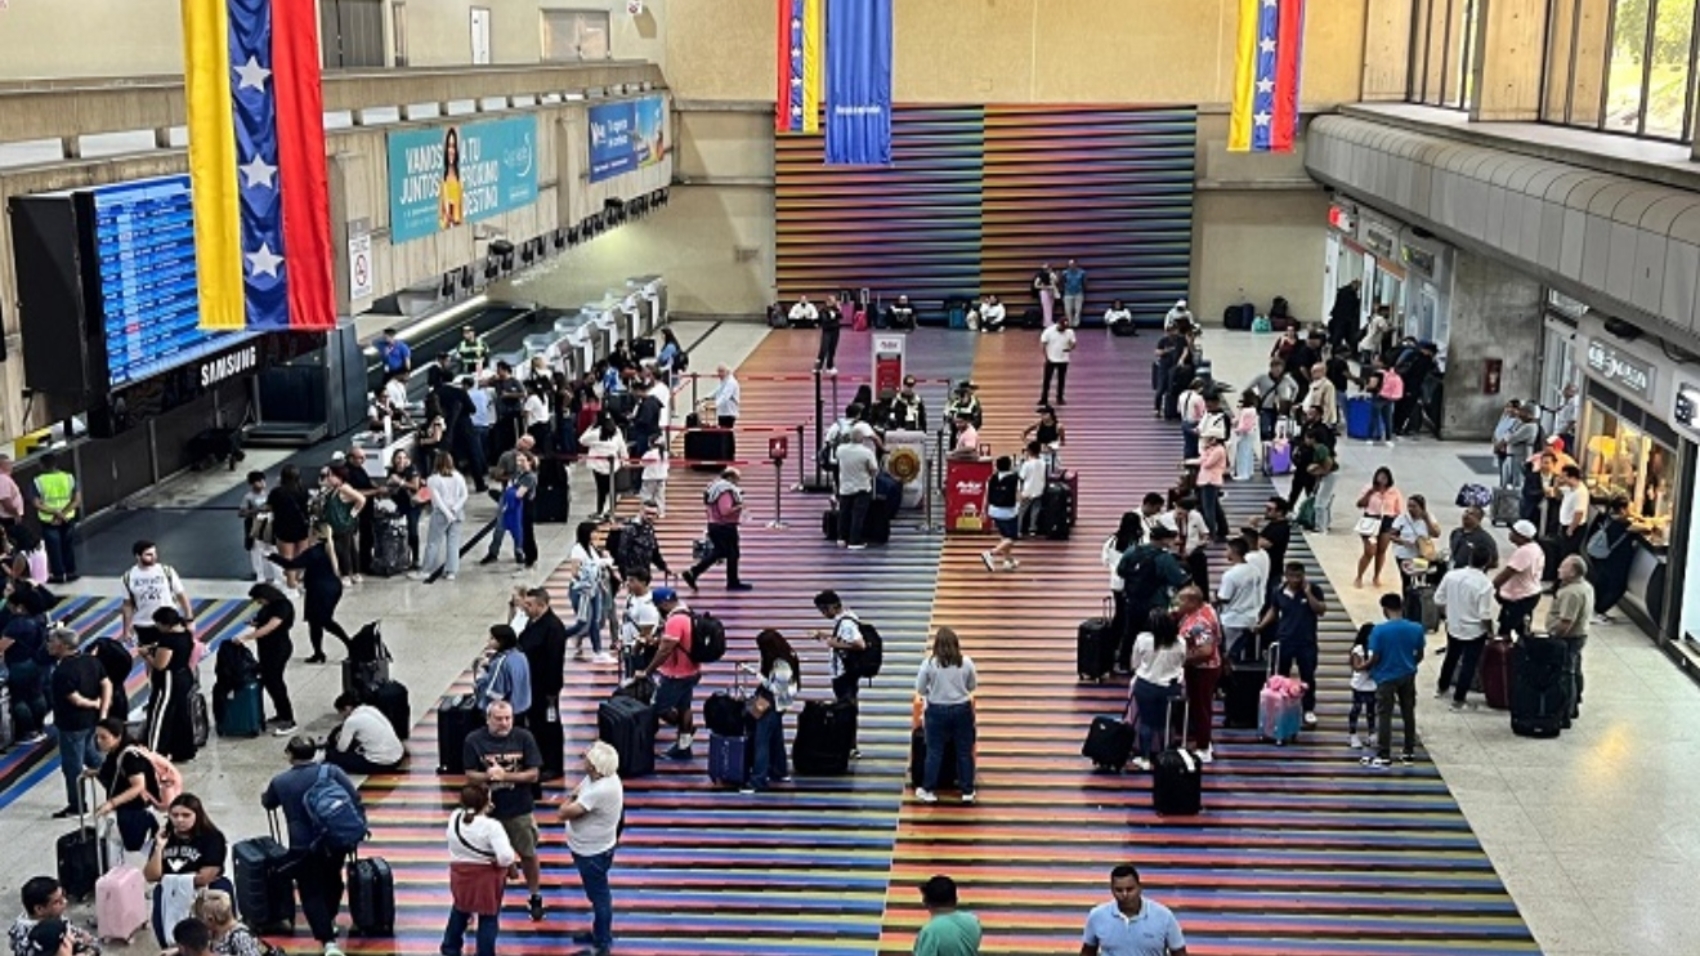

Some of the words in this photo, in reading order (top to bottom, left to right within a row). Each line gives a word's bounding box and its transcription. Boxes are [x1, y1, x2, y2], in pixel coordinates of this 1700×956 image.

[404, 143, 444, 174] VAMOS
[459, 139, 469, 165] A
[468, 136, 481, 162] TU
[399, 171, 440, 205] JUNTOS
[463, 186, 498, 217] DESTINO
[201, 346, 256, 387] SAMSUNG
